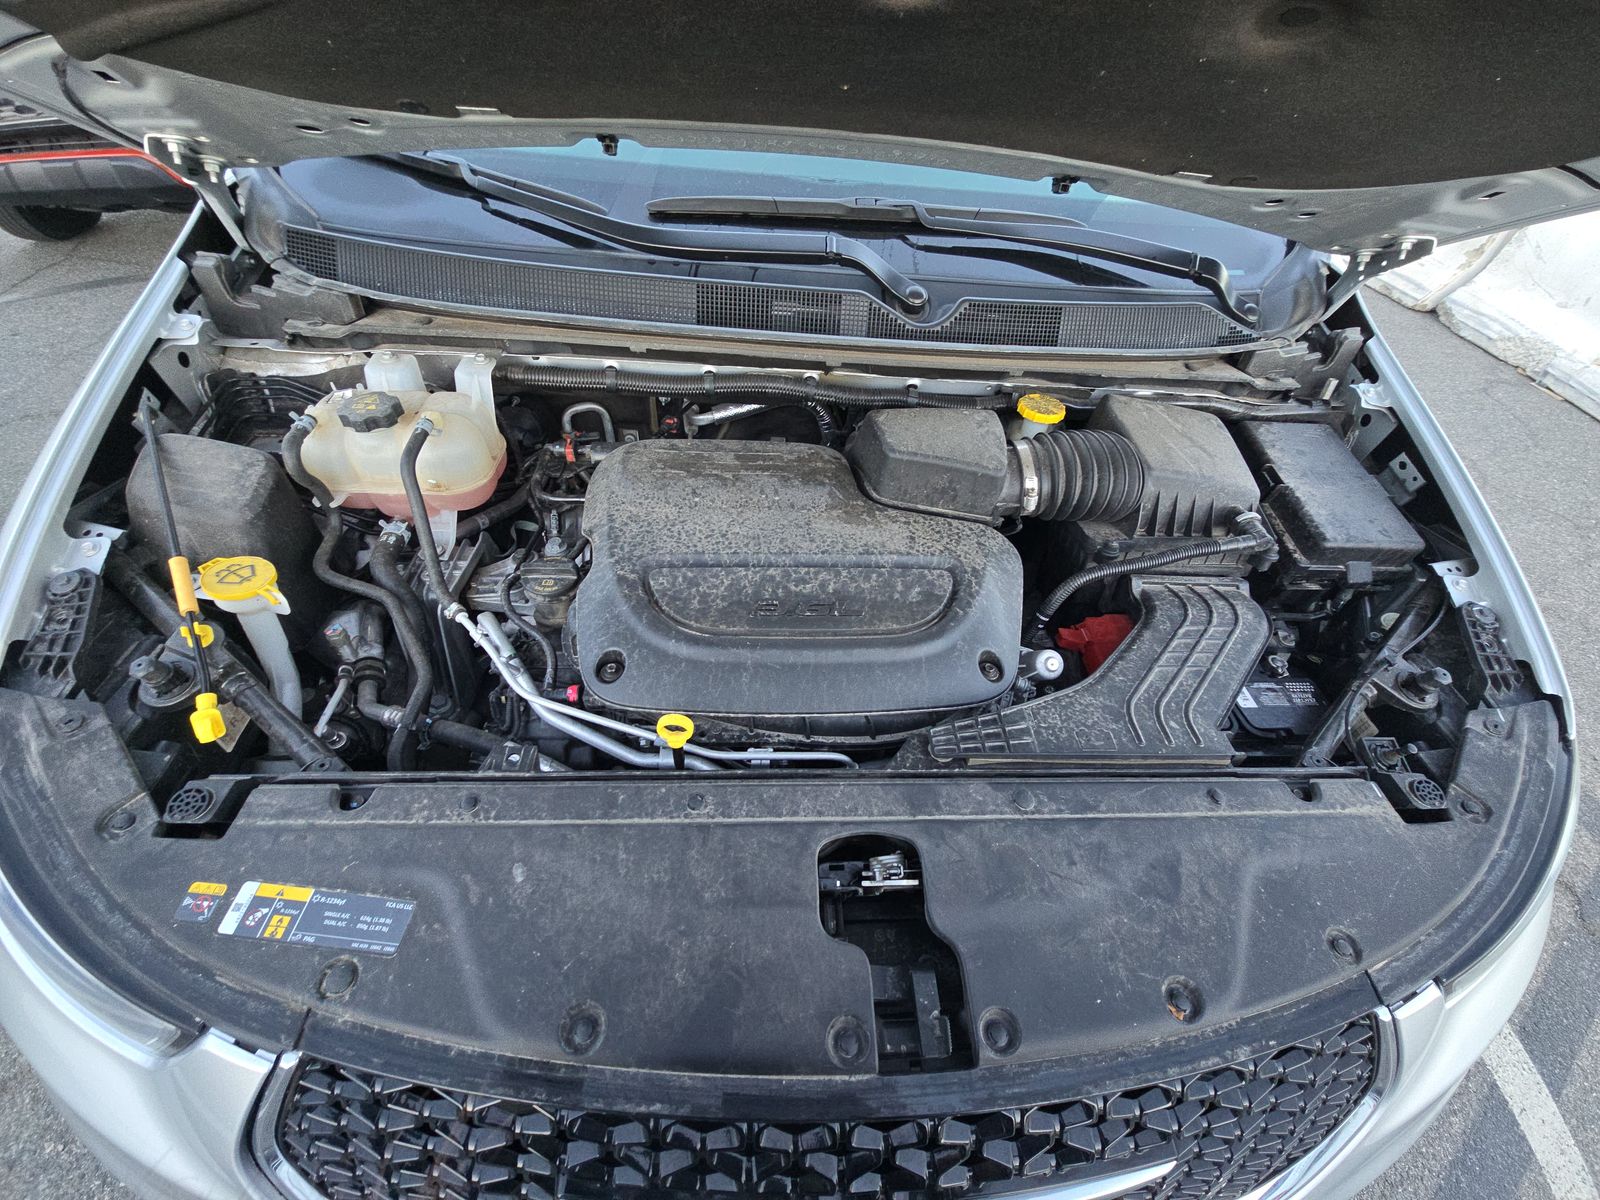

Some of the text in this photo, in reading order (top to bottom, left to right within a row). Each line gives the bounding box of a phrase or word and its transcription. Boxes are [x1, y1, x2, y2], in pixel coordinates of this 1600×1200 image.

[385, 901, 414, 911] FCA US LLC
